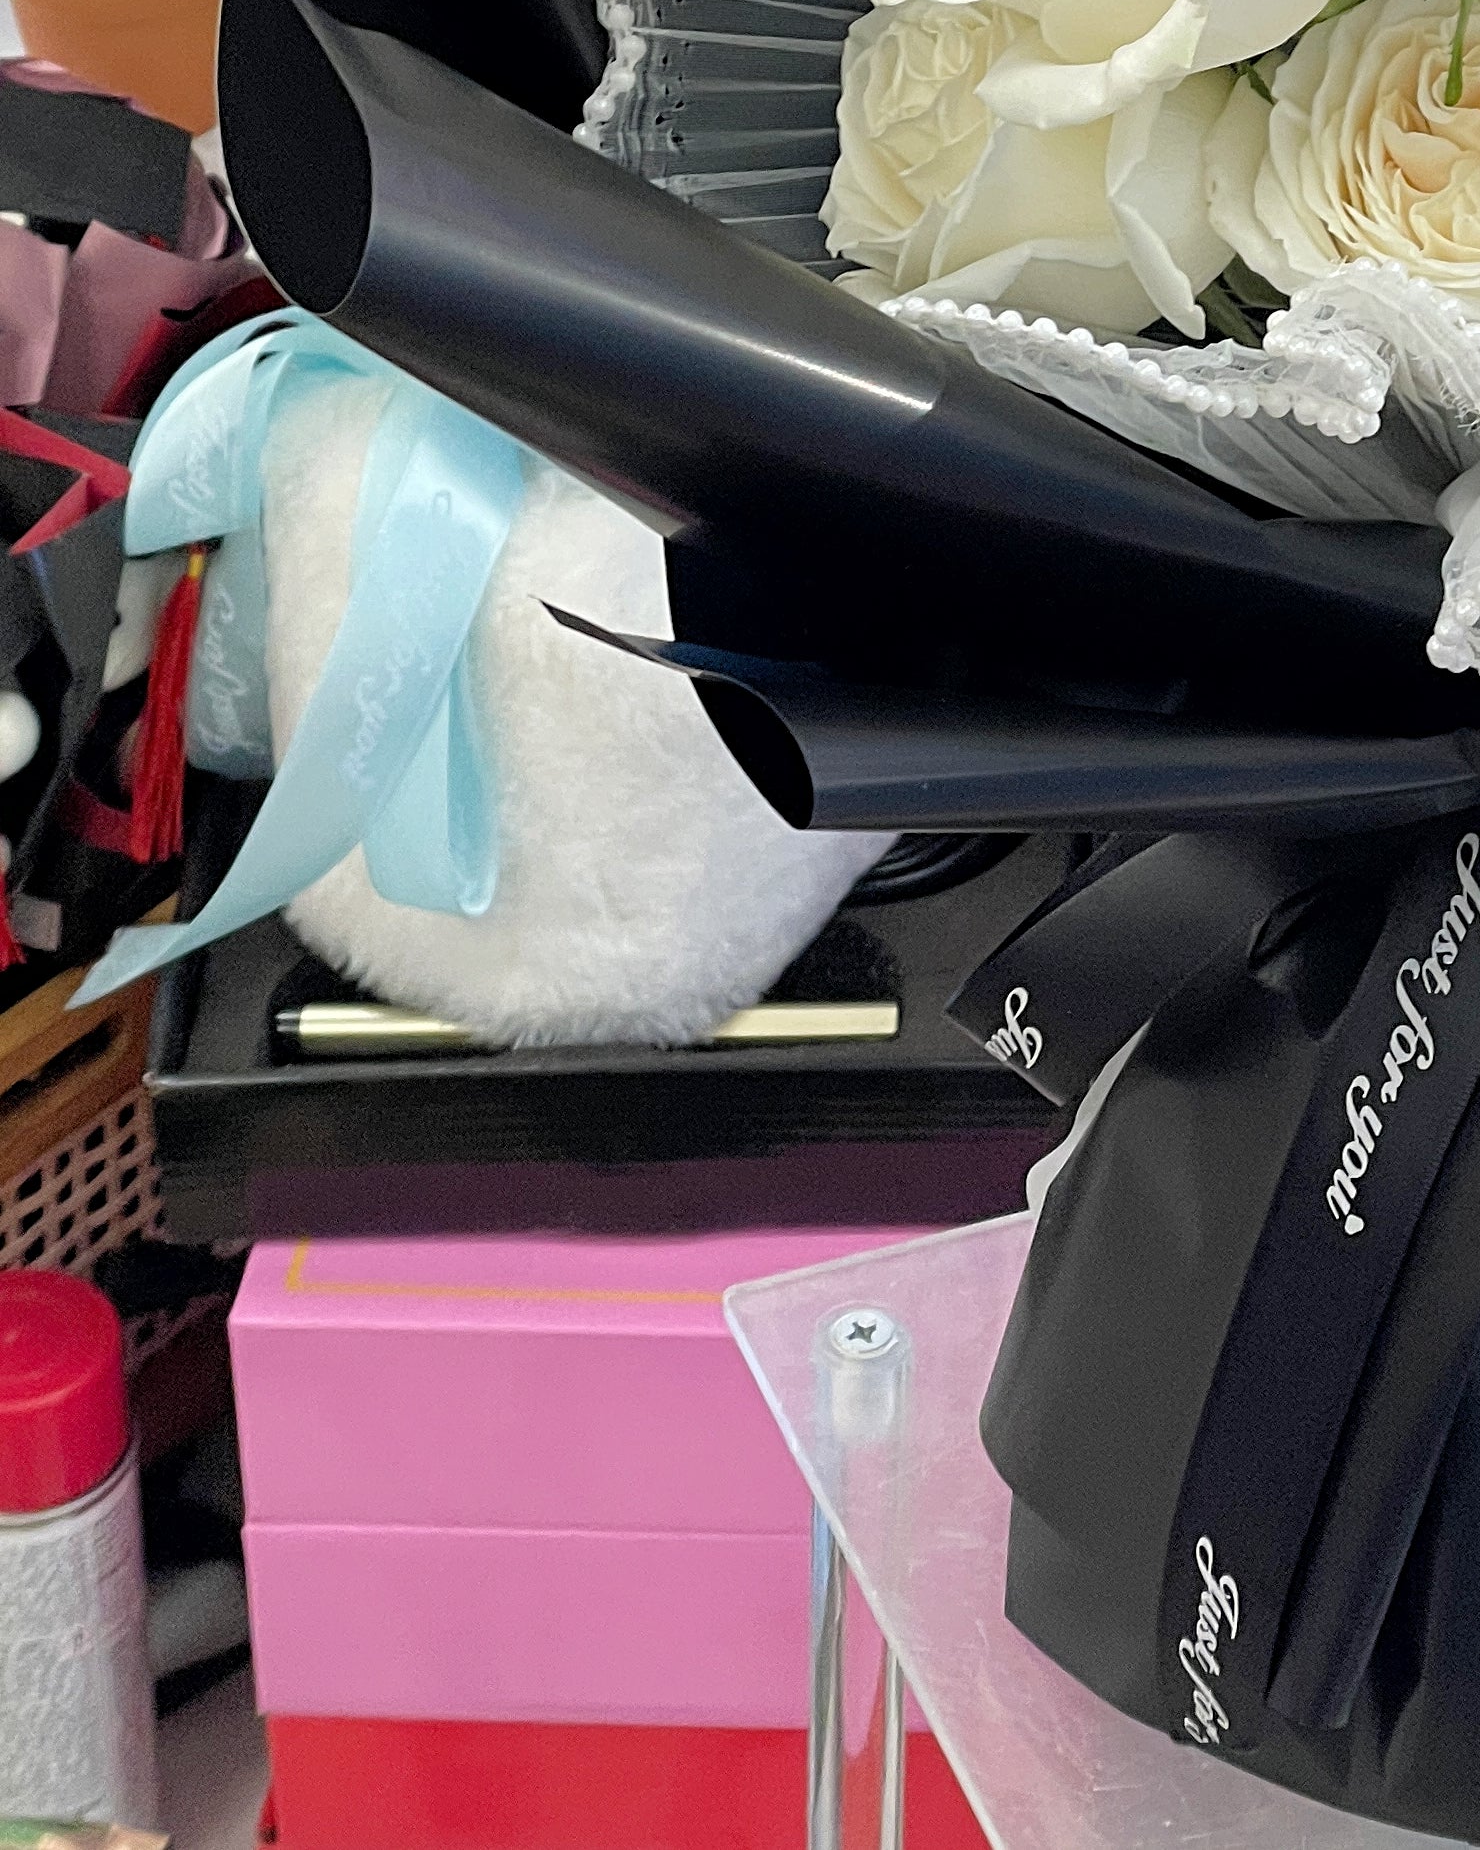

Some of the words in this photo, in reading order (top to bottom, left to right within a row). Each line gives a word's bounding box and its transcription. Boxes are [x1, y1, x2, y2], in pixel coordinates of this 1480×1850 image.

[1380, 958, 1435, 1104] for
[1326, 1074, 1383, 1236] you
[1194, 1536, 1239, 1677] Just
